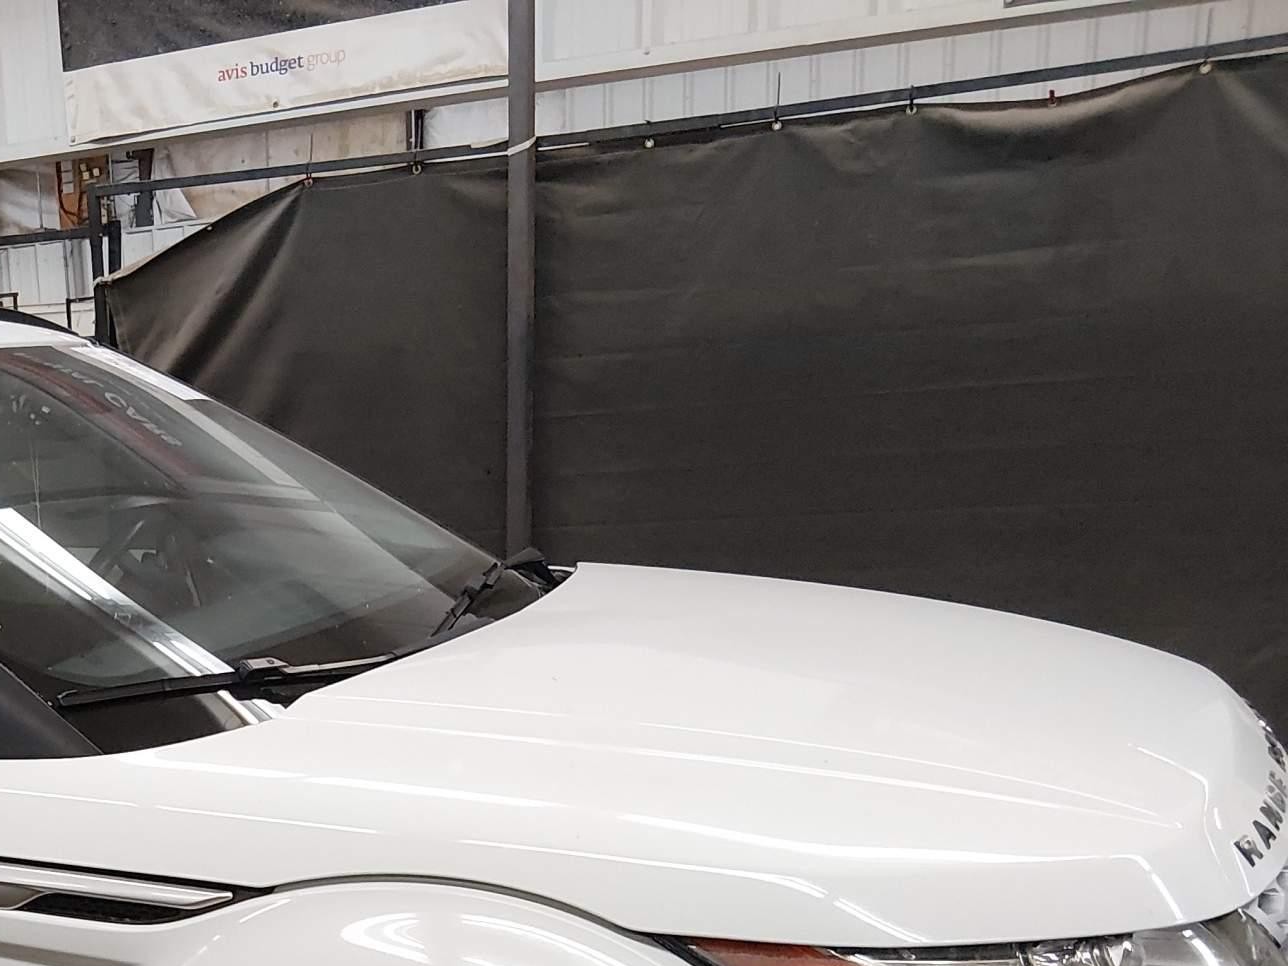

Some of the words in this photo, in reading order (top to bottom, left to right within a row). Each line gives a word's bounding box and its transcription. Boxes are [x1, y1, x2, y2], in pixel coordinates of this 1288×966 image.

[217, 63, 248, 82] avis
[250, 54, 304, 78] budget
[306, 47, 346, 72] group
